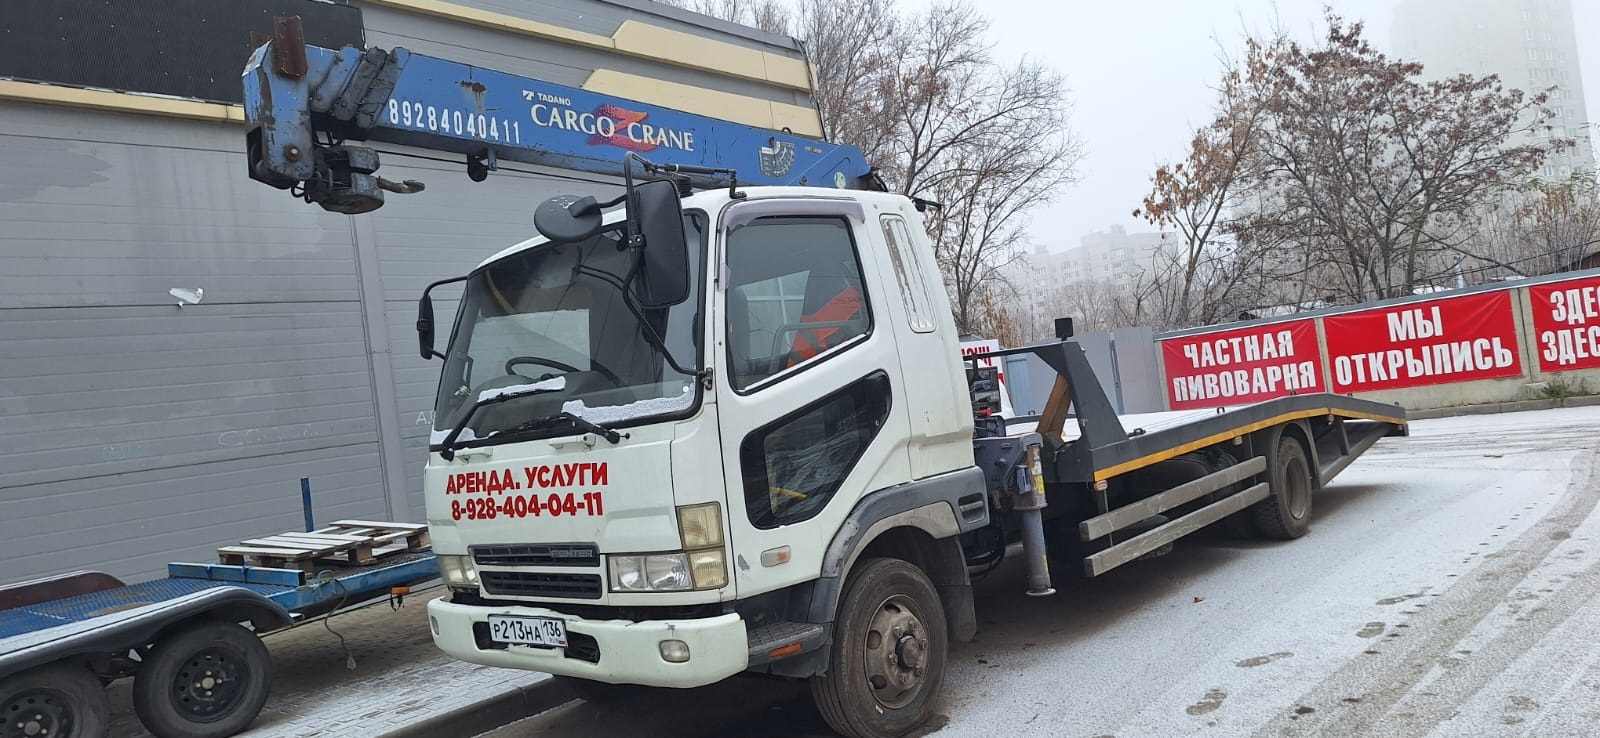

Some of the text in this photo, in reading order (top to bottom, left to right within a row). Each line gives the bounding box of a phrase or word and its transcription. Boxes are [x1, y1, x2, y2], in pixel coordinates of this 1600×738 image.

[537, 92, 571, 106] TADANO
[388, 98, 520, 144] 89284040411
[530, 103, 615, 137] CARGO
[627, 122, 694, 151] CRANE
[1387, 306, 1443, 342] МЫ
[1183, 330, 1294, 368] ЧАСТНАЯ
[1173, 361, 1316, 402] ПИВОВАРНЯ
[446, 462, 608, 496] АРЕНДА. УСЛУГИ
[451, 492, 603, 520] 8-928-404-04-11
[543, 621, 561, 637] 136
